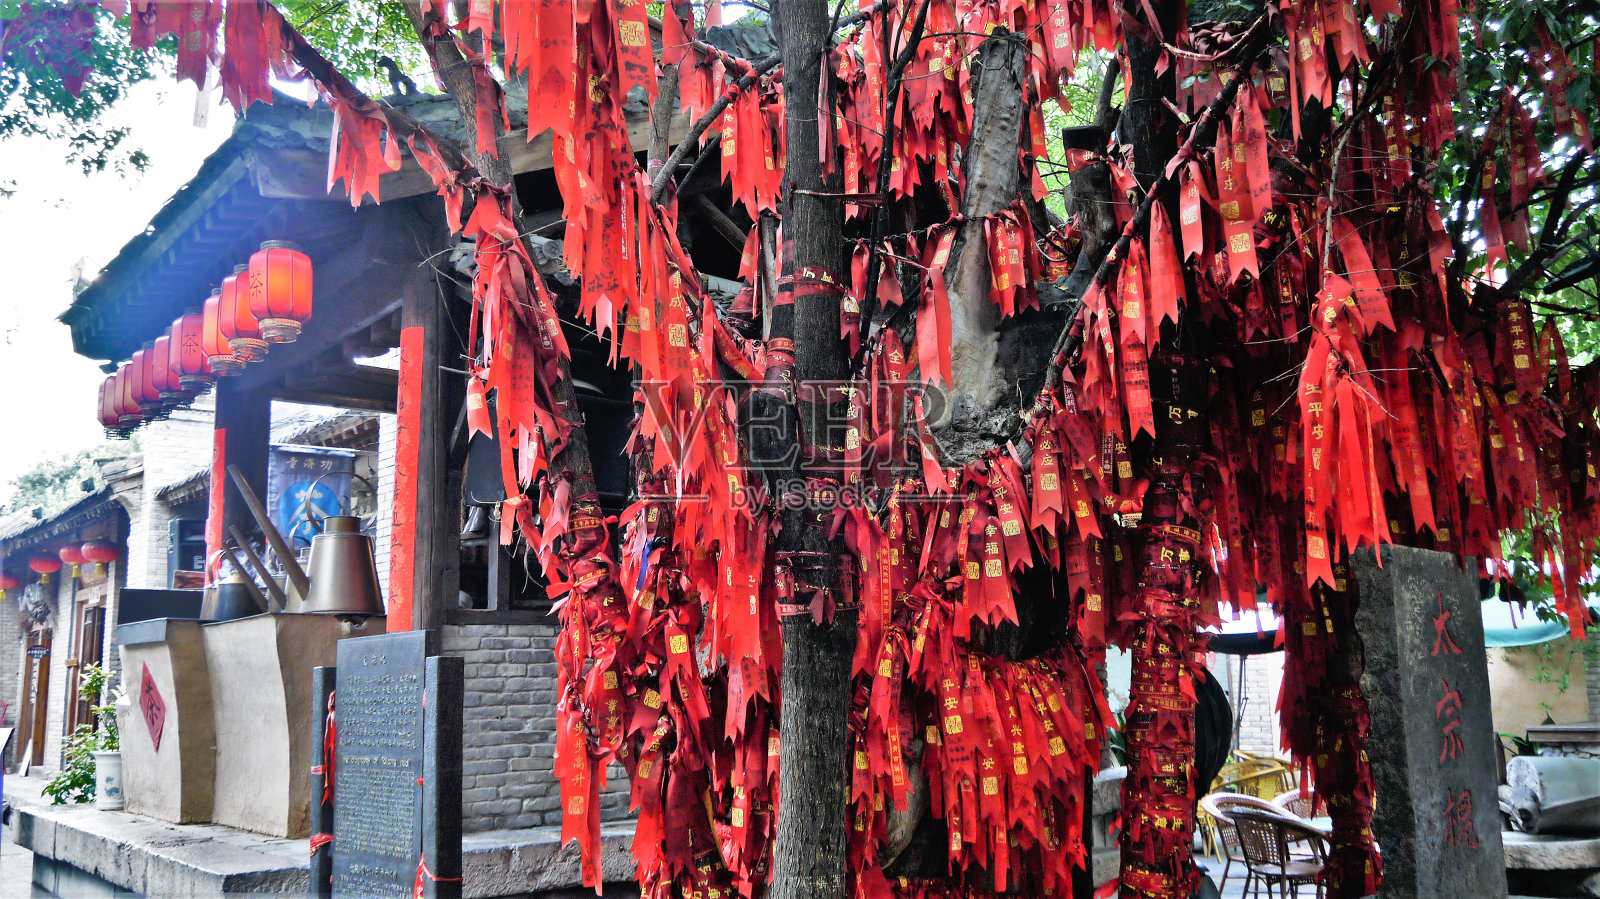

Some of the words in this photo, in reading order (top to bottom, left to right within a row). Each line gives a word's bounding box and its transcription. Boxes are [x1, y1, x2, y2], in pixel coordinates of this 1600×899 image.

[250, 270, 264, 298] 茶
[182, 331, 199, 355] 茶
[985, 524, 998, 555] 幸福
[942, 678, 959, 711] 平安
[571, 720, 585, 787] 步步高升
